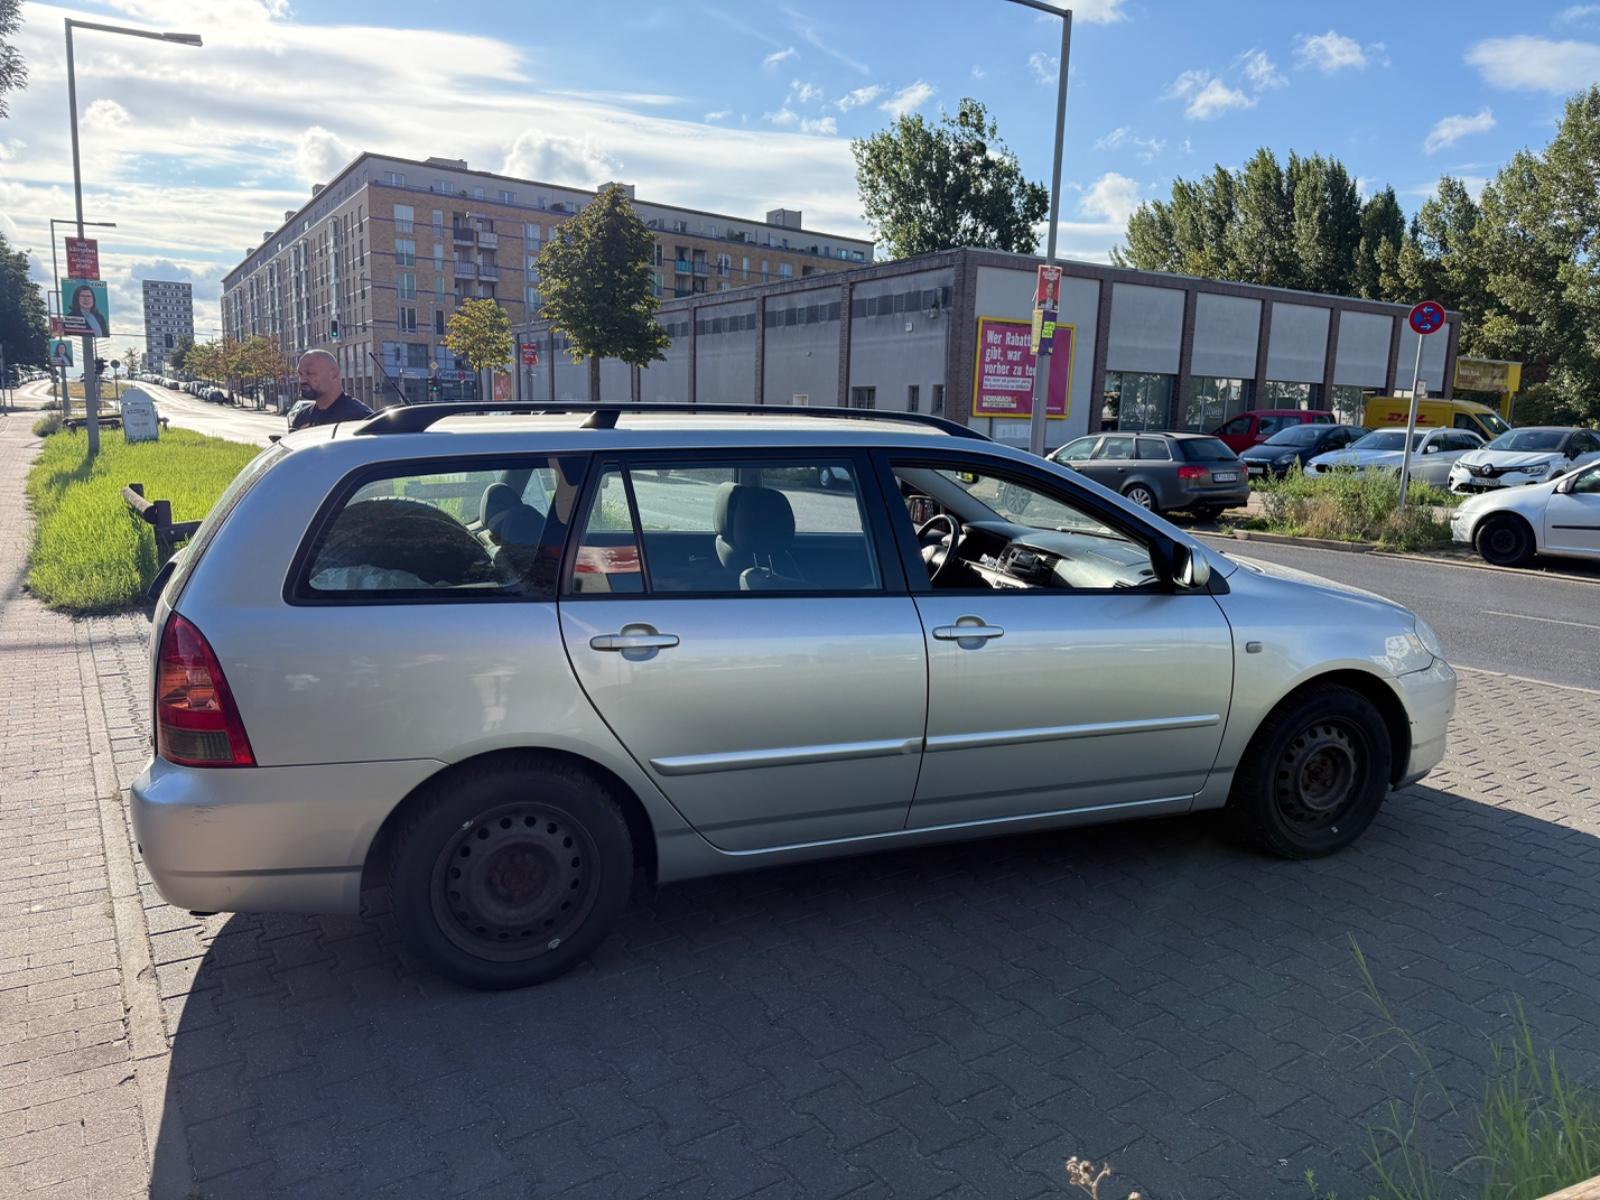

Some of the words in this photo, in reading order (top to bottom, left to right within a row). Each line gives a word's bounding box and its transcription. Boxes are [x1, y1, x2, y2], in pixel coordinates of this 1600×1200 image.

[987, 330, 1002, 344] Wer
[1005, 332, 1032, 346] Rabatt
[985, 346, 1004, 362] gibt,
[1007, 350, 1022, 361] war
[984, 363, 1009, 375] vorher
[1013, 366, 1022, 375] zu
